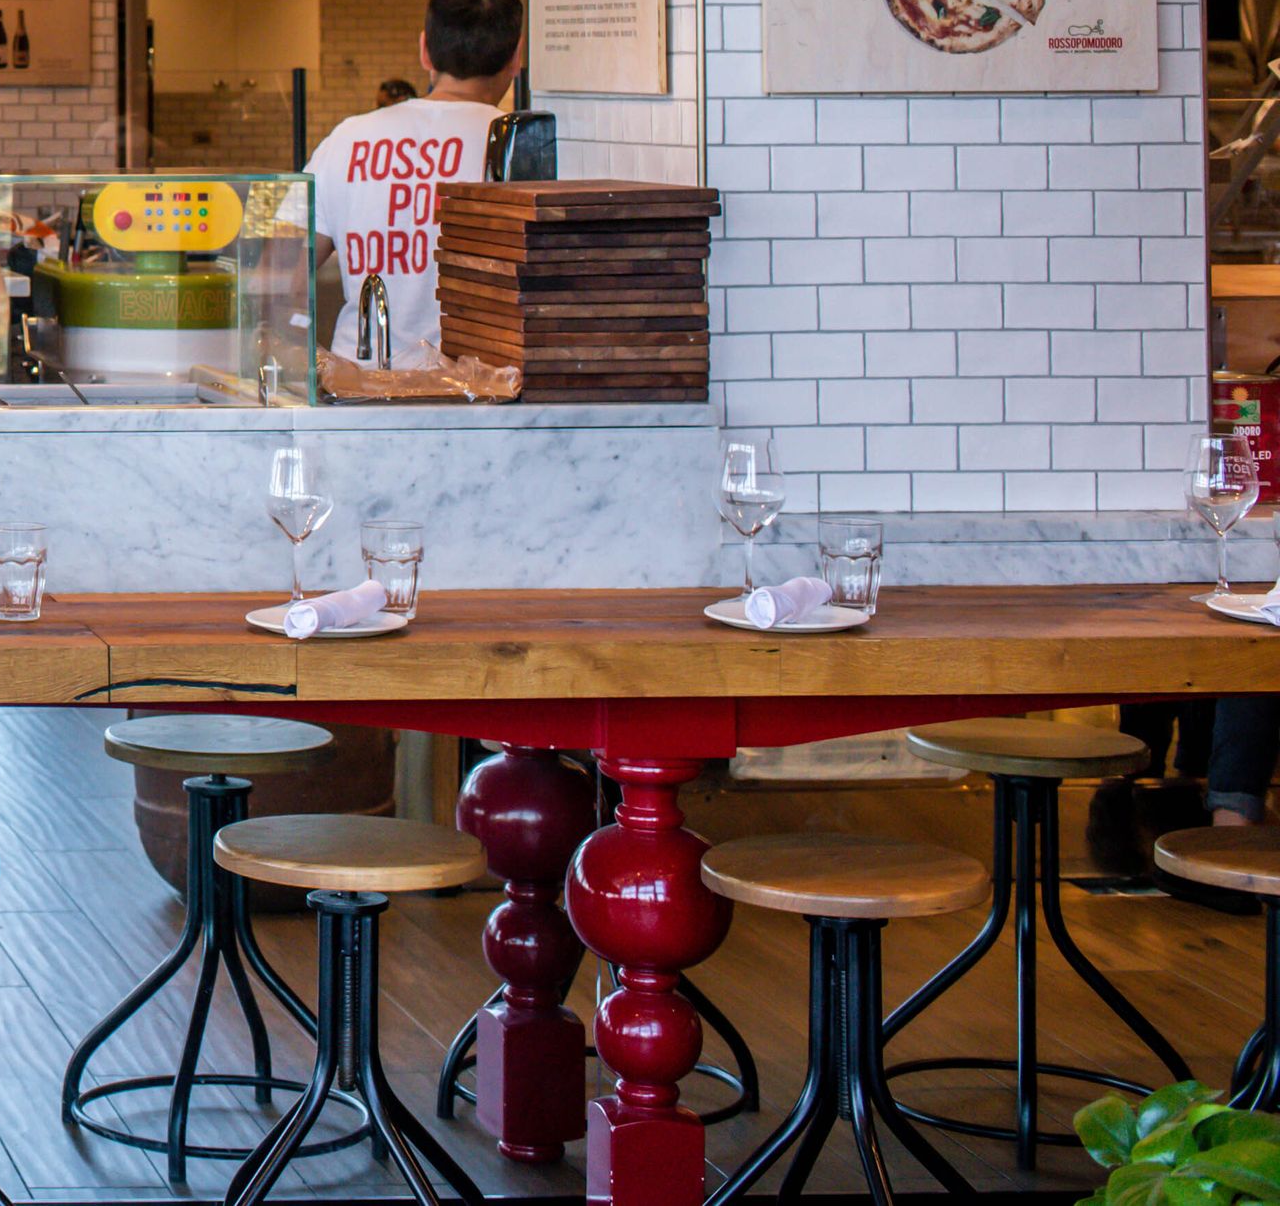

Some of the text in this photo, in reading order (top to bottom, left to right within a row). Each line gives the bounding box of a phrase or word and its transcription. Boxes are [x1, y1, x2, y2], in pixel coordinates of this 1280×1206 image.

[1048, 37, 1123, 49] ROSSOPOMODORO
[347, 136, 464, 183] ROSSO
[388, 181, 441, 227] PO
[346, 229, 428, 275] DORO
[1233, 425, 1261, 436] ODORO
